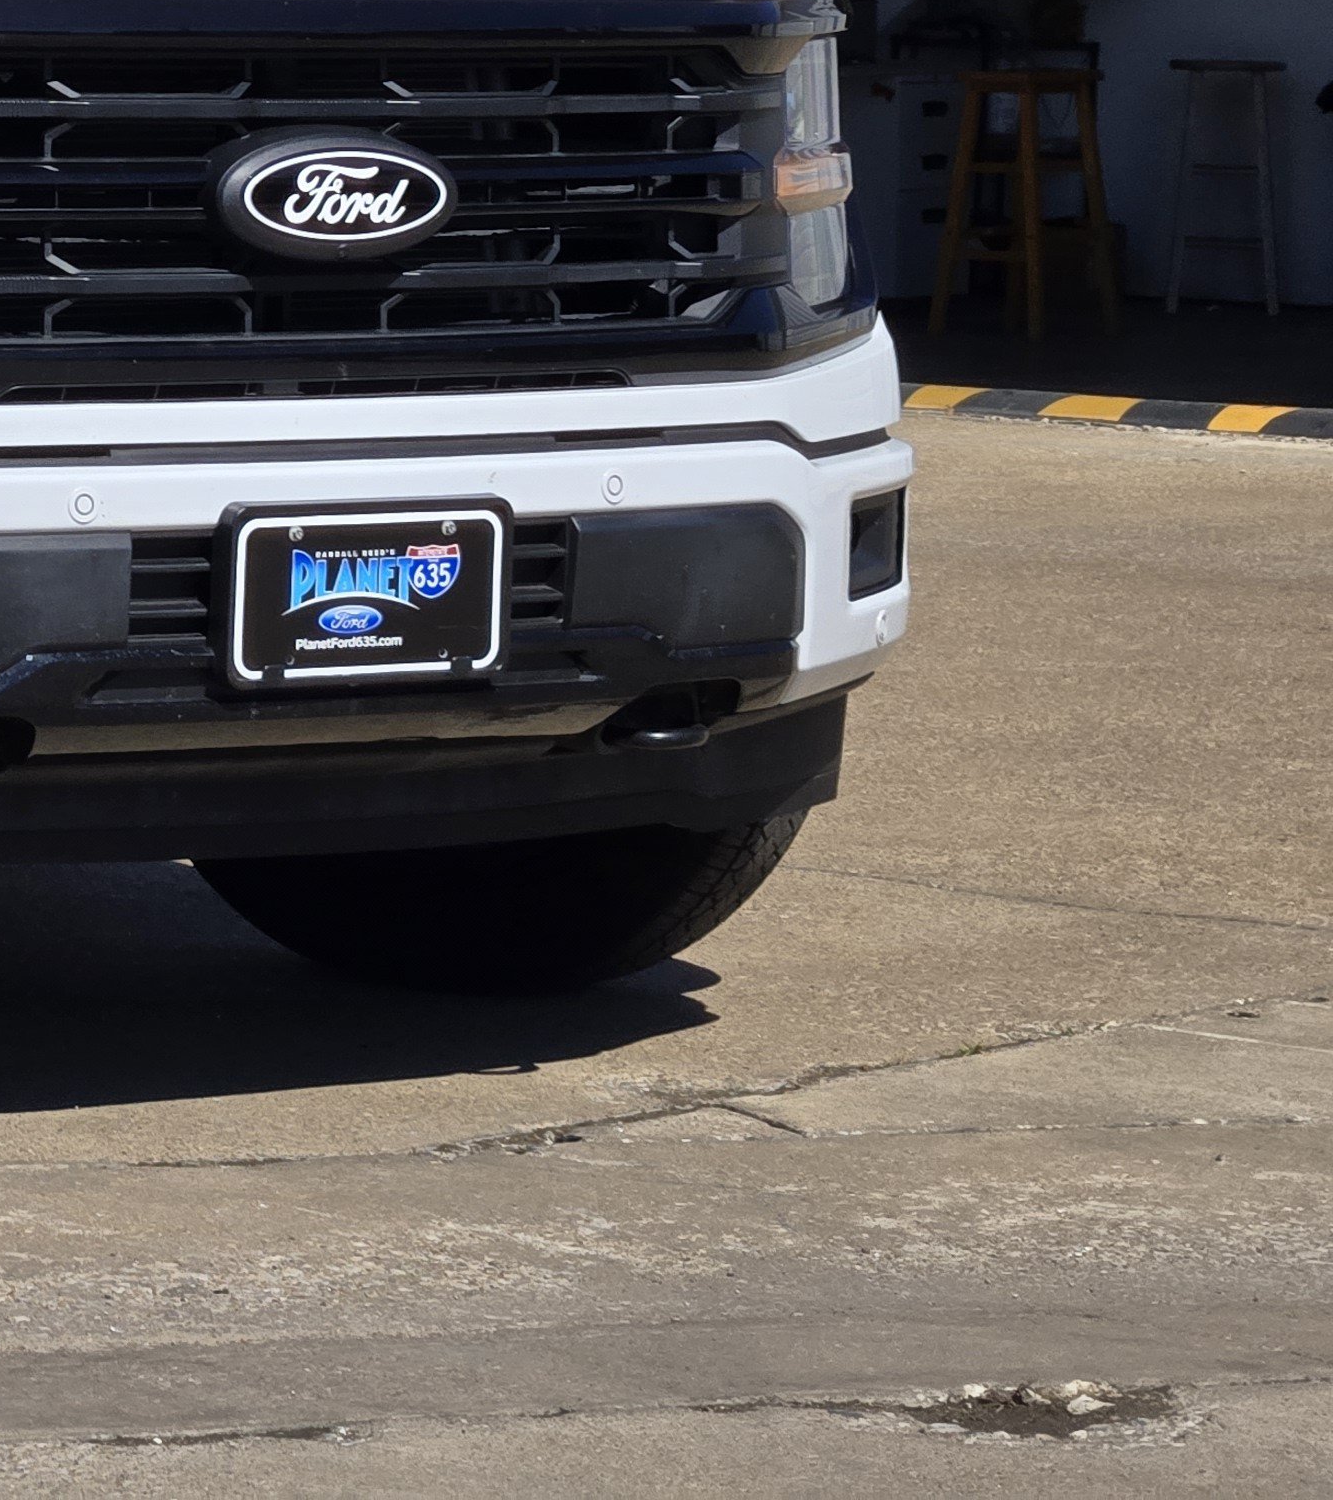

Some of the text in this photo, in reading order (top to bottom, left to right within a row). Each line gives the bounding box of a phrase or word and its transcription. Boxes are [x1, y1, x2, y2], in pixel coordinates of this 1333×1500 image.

[283, 163, 410, 225] Ford
[290, 549, 413, 611] PLANET
[412, 562, 451, 588] 635
[330, 610, 371, 630] Ford
[295, 635, 403, 651] PlanetFord635.com
